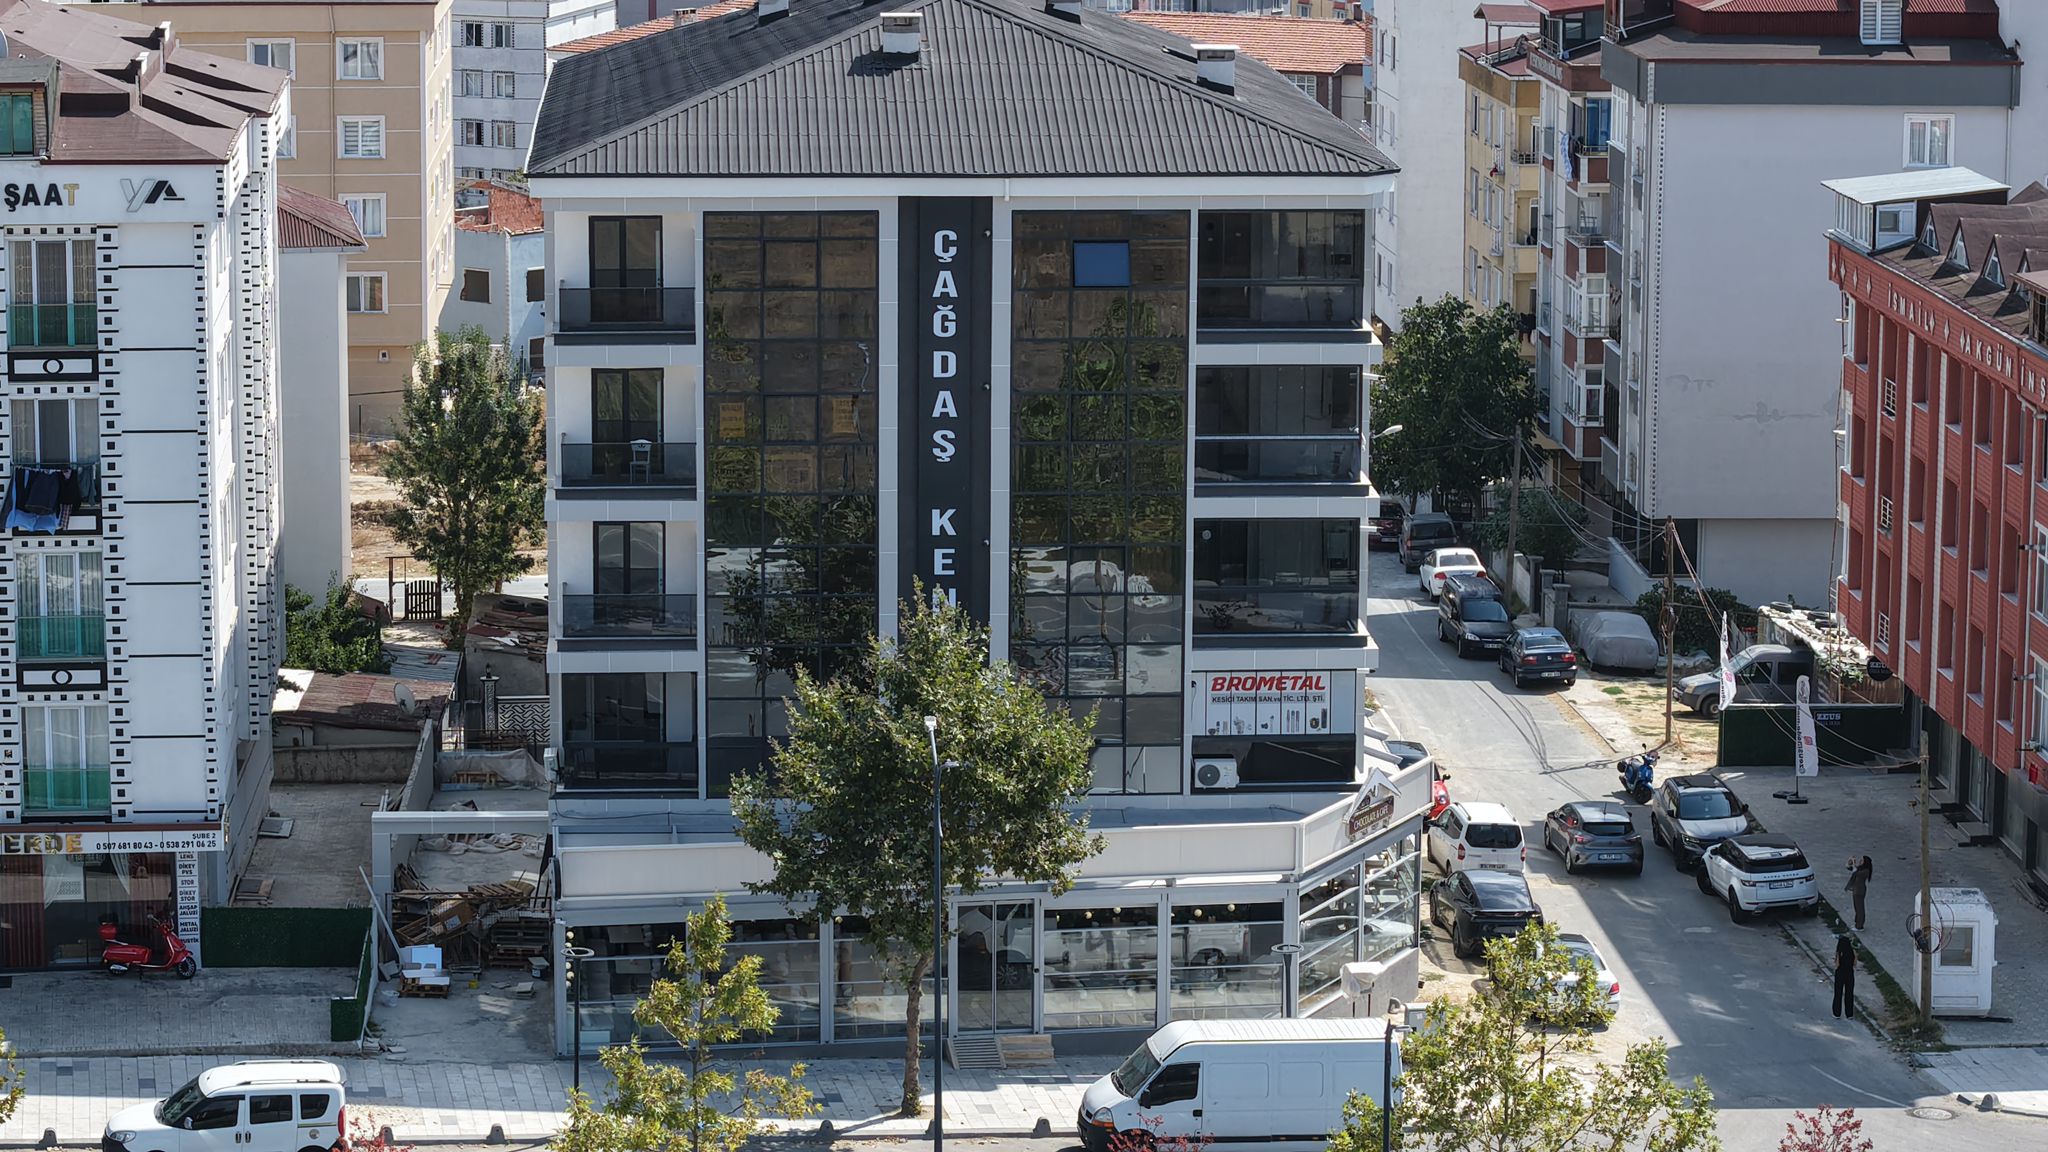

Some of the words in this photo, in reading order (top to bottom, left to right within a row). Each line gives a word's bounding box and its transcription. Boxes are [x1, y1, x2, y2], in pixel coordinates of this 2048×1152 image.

[4, 183, 79, 212] ŞAAT
[1888, 282, 1929, 332] İSMAİL
[1965, 334, 2012, 378] AKGÜN
[932, 229, 958, 463] ÇAĞDAŞ
[1211, 675, 1326, 692] BROMETAL
[96, 842, 101, 850] 0
[102, 842, 116, 850] 507
[118, 842, 131, 850] 681
[143, 841, 153, 849] 43
[207, 840, 216, 848] 25
